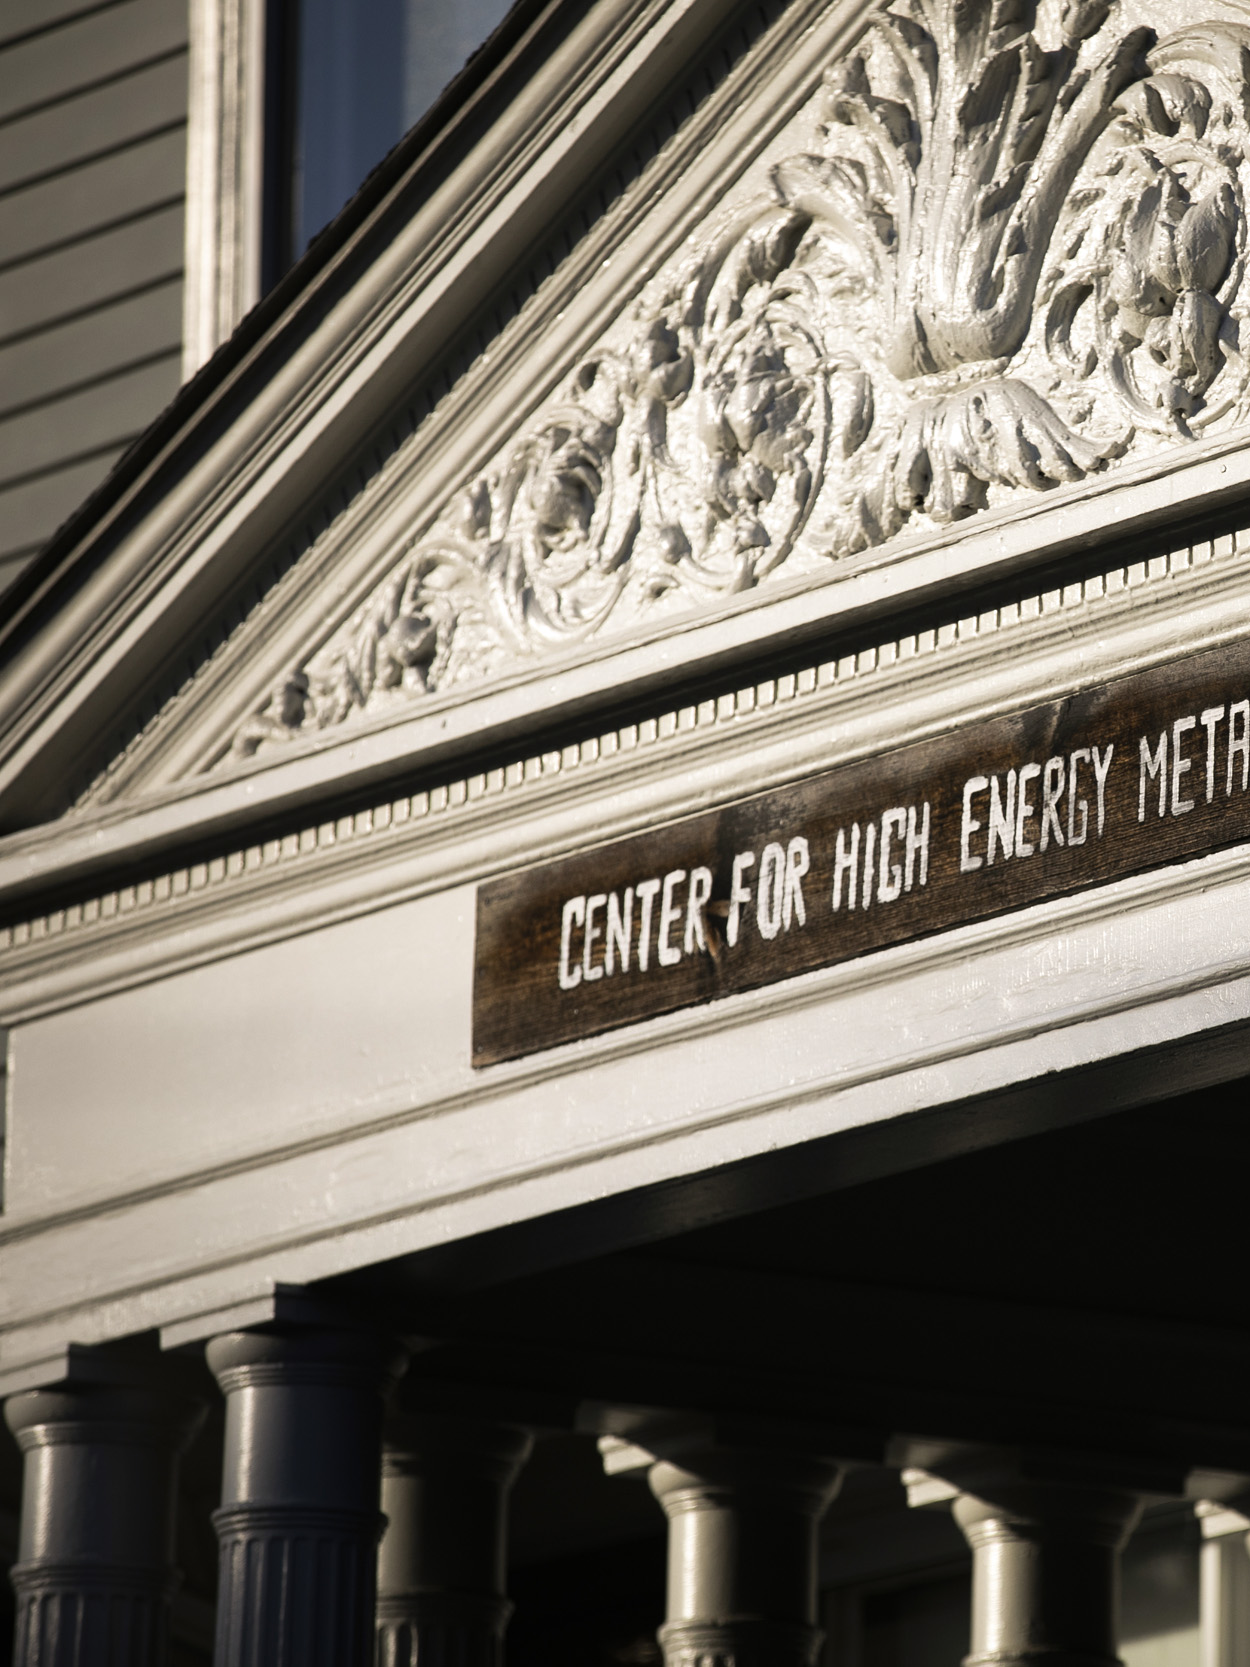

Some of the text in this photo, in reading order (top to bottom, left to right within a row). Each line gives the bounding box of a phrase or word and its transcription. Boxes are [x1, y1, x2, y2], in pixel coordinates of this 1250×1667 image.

[558, 867, 713, 989] CENTER
[727, 836, 811, 947] FOR
[832, 802, 931, 911] HIGH
[960, 744, 1114, 872] ENERGY
